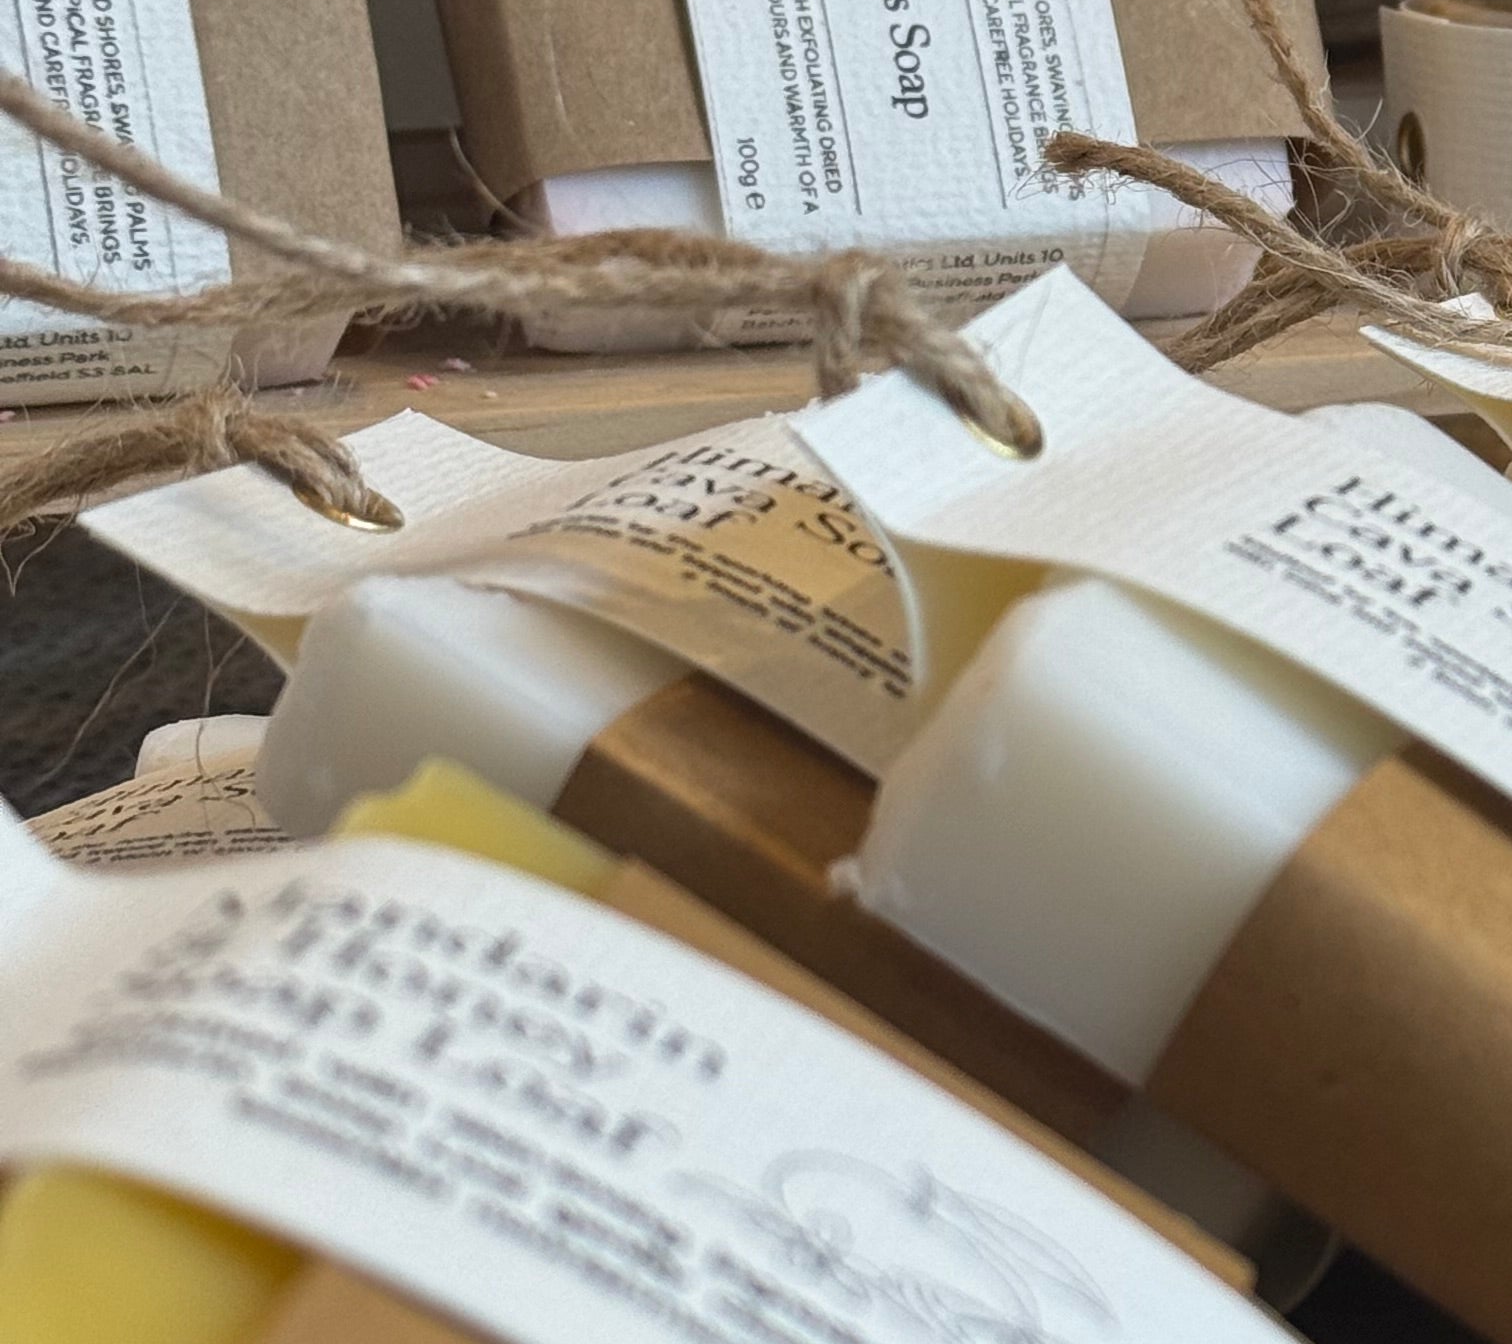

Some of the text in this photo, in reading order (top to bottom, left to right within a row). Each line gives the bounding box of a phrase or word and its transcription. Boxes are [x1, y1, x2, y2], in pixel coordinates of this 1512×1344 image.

[774, 42, 797, 80] AND
[889, 24, 931, 119] Soap
[1010, 13, 1046, 122] FRAGRANCE
[94, 16, 125, 97] SHORES,
[124, 202, 153, 270] PALMS
[782, 85, 812, 166] WARMTH
[796, 16, 832, 131] EXFOLIATING
[818, 137, 843, 193] DRIED
[729, 137, 762, 186] 100g
[797, 171, 817, 197] OF
[93, 187, 122, 264] BRINGS
[984, 248, 1064, 267] Units 10
[40, 329, 99, 346] Units
[60, 351, 110, 364] Park
[1273, 513, 1448, 608] Loaf
[1303, 493, 1474, 598] Cava
